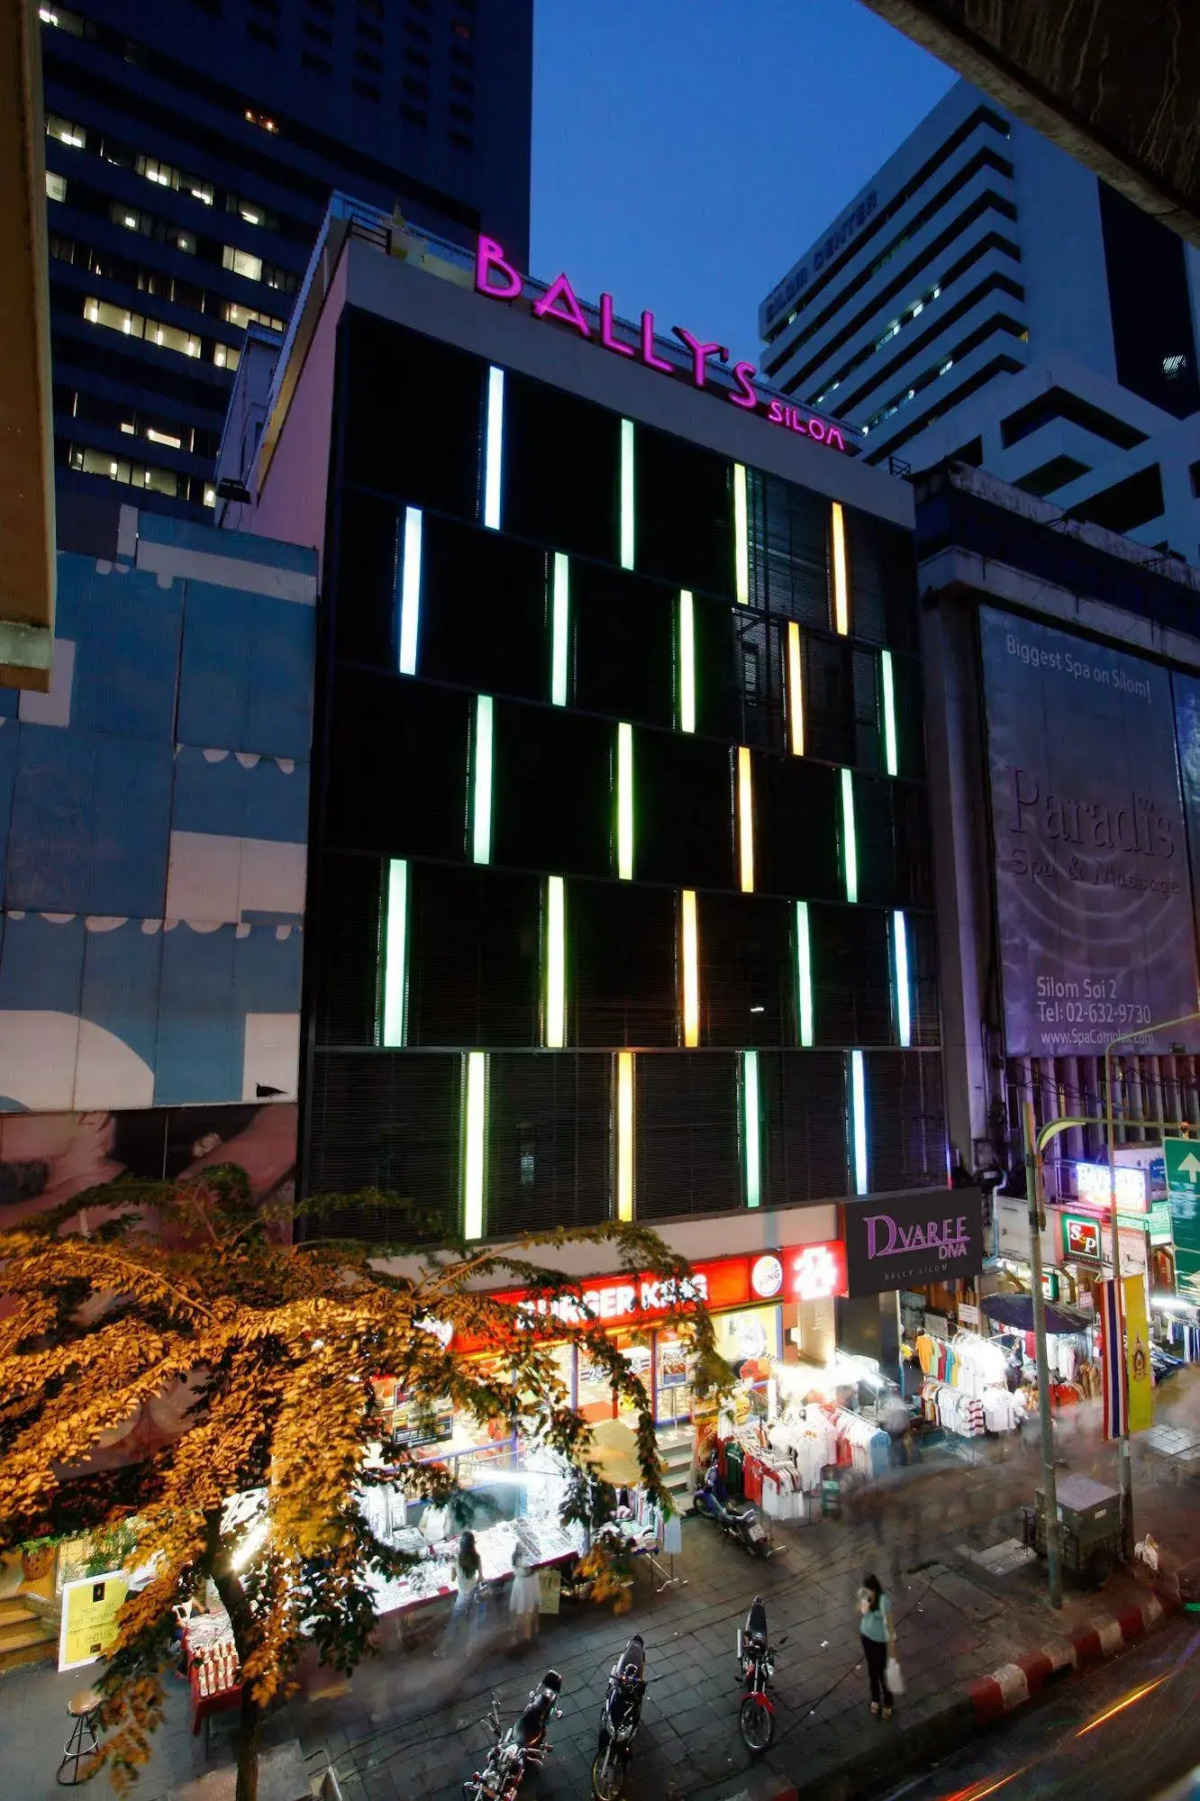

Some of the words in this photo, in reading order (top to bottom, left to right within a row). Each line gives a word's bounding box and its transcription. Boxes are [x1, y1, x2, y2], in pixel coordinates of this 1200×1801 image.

[813, 190, 878, 272] CENTER
[475, 233, 758, 409] BALLY'S
[767, 400, 846, 451] SILOM
[1006, 633, 1063, 671] Biggest
[1064, 654, 1091, 679] Spa
[1093, 668, 1110, 686] on
[1009, 769, 1175, 860] Paradis
[1012, 848, 1056, 883] Spa
[1068, 856, 1083, 881] &
[1036, 976, 1080, 998] Silom
[1083, 978, 1106, 999] Soi
[1109, 980, 1117, 999] 2
[1040, 1028, 1154, 1046] www.SpaComplex.com
[938, 1246, 968, 1260] DIVA
[1070, 1224, 1096, 1254] S&P
